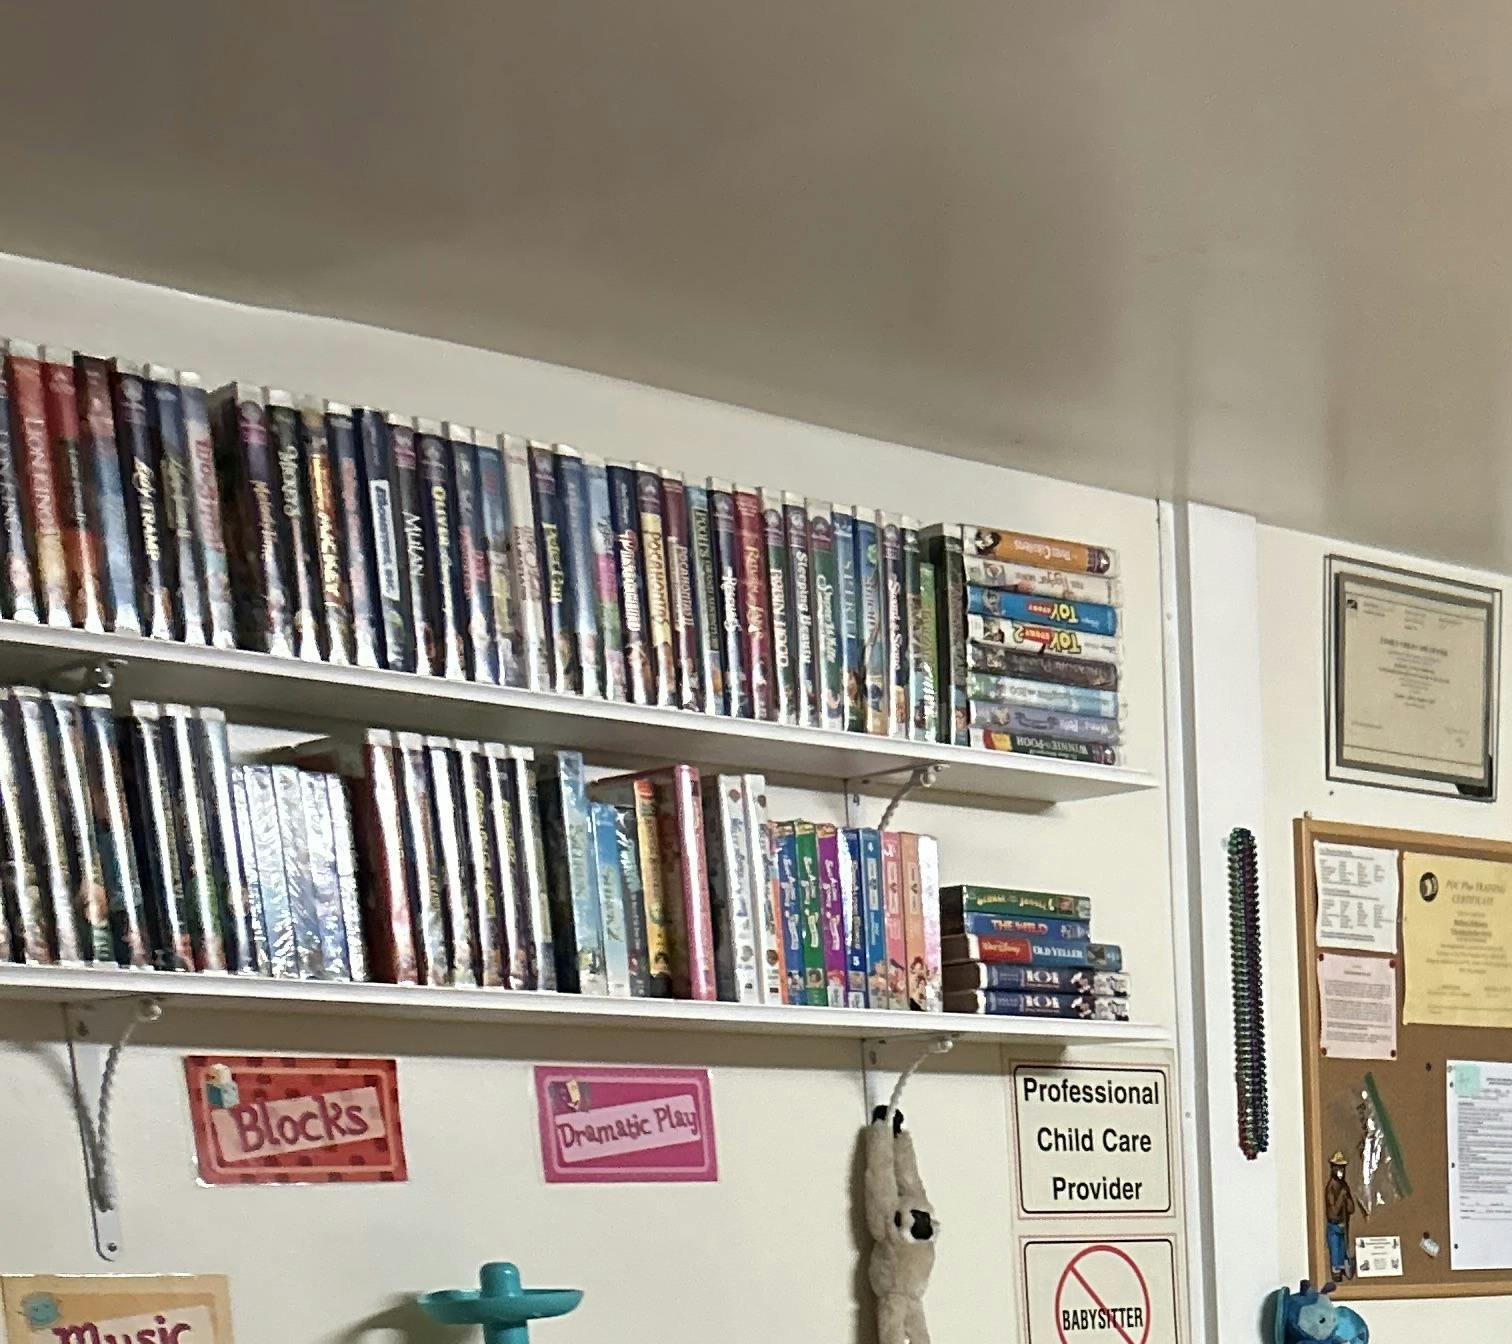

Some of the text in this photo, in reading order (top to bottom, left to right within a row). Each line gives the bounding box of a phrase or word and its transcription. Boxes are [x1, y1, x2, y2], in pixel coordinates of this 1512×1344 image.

[402, 512, 424, 576] MULAN
[678, 546, 693, 617] POCAHONTAS
[795, 550, 809, 611] Sleeping
[1051, 603, 1078, 623] TOY
[776, 621, 789, 667] HOOD
[1013, 625, 1024, 643] 2
[1050, 631, 1081, 654] TOY
[1015, 736, 1044, 750] POOH
[1051, 741, 1088, 754] WINNIE
[991, 920, 1012, 930] THE
[1033, 946, 1052, 957] OLD
[1053, 947, 1083, 959] YELLER
[1026, 970, 1059, 984] 101
[1025, 995, 1060, 1009] 101
[1023, 1077, 1160, 1105] Professional
[236, 1100, 370, 1152] Blocks
[558, 1107, 698, 1150] Dramatic Play
[1037, 1127, 1152, 1153] Child Care
[1053, 1176, 1143, 1201] Provider
[1062, 1307, 1144, 1331] BABYSITTER
